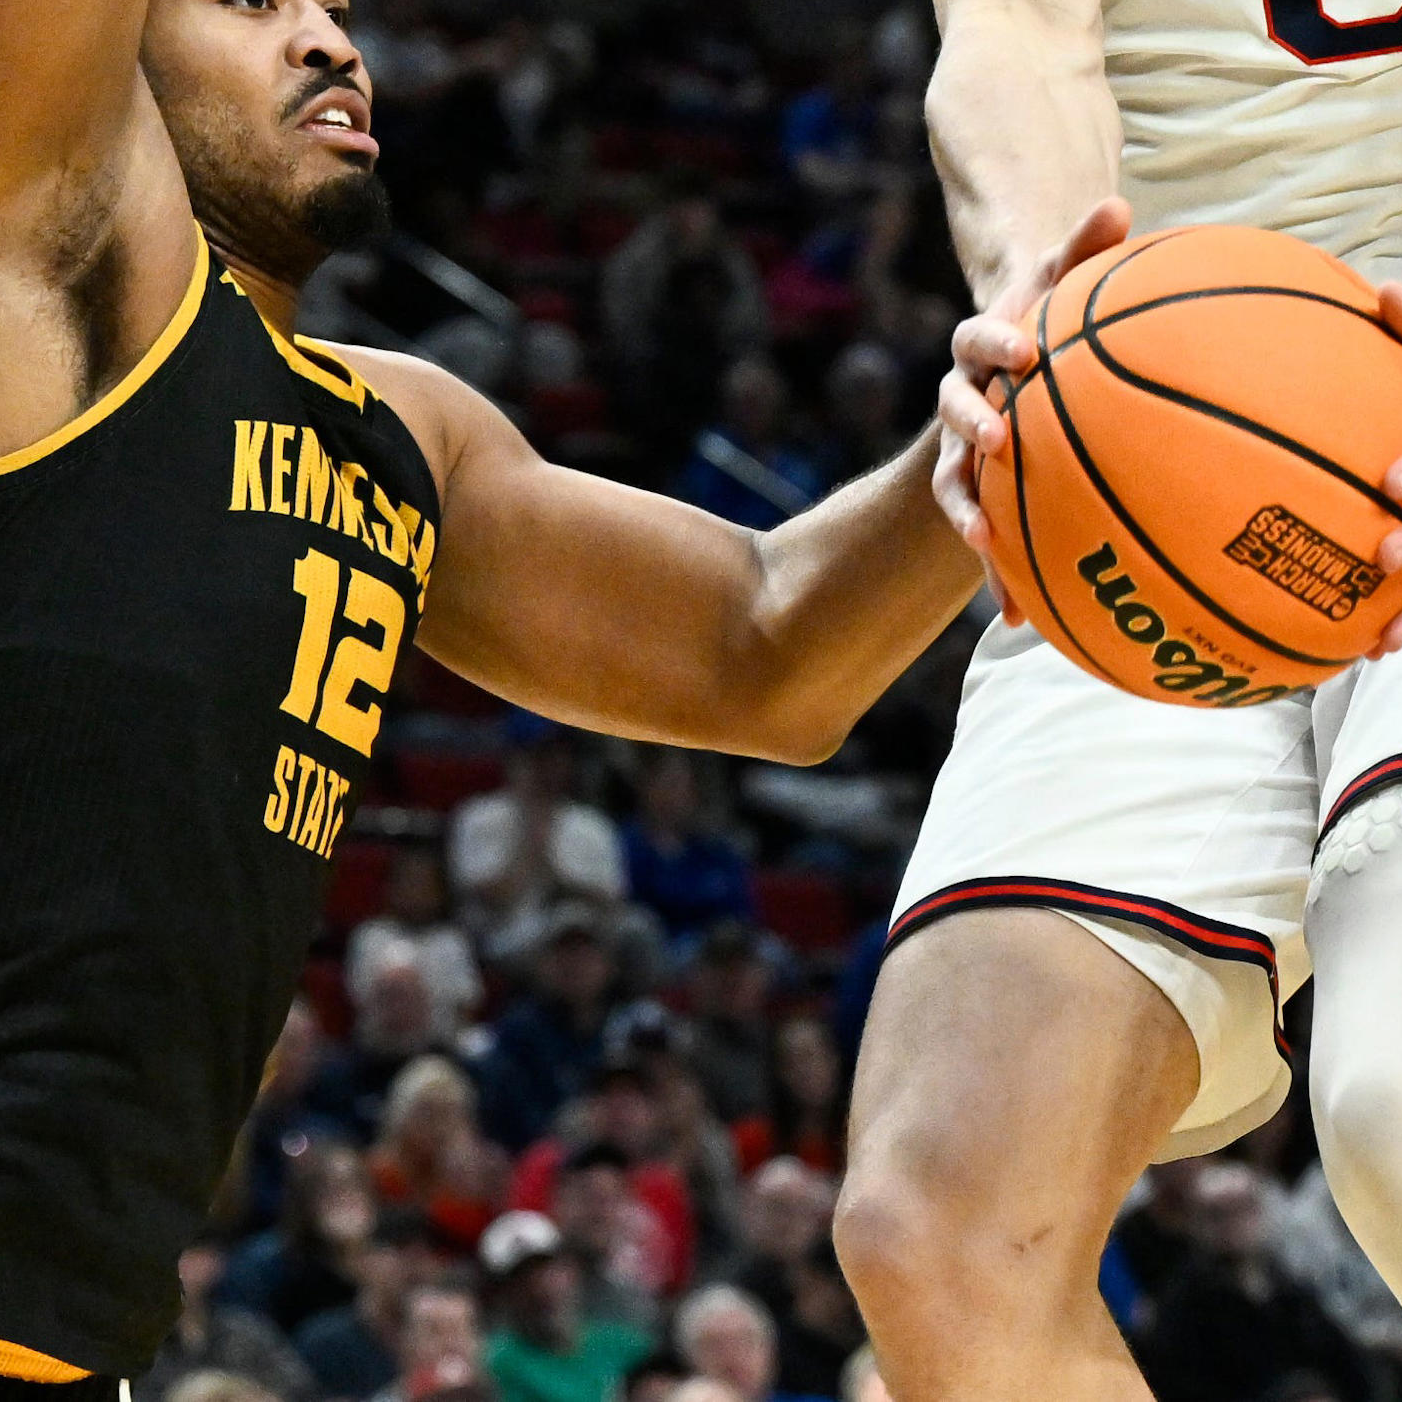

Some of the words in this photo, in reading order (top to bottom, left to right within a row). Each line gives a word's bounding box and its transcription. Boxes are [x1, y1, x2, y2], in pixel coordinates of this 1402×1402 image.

[1250, 510, 1351, 586] MADNESS
[1266, 555, 1342, 610] MARCH
[279, 547, 406, 759] 12
